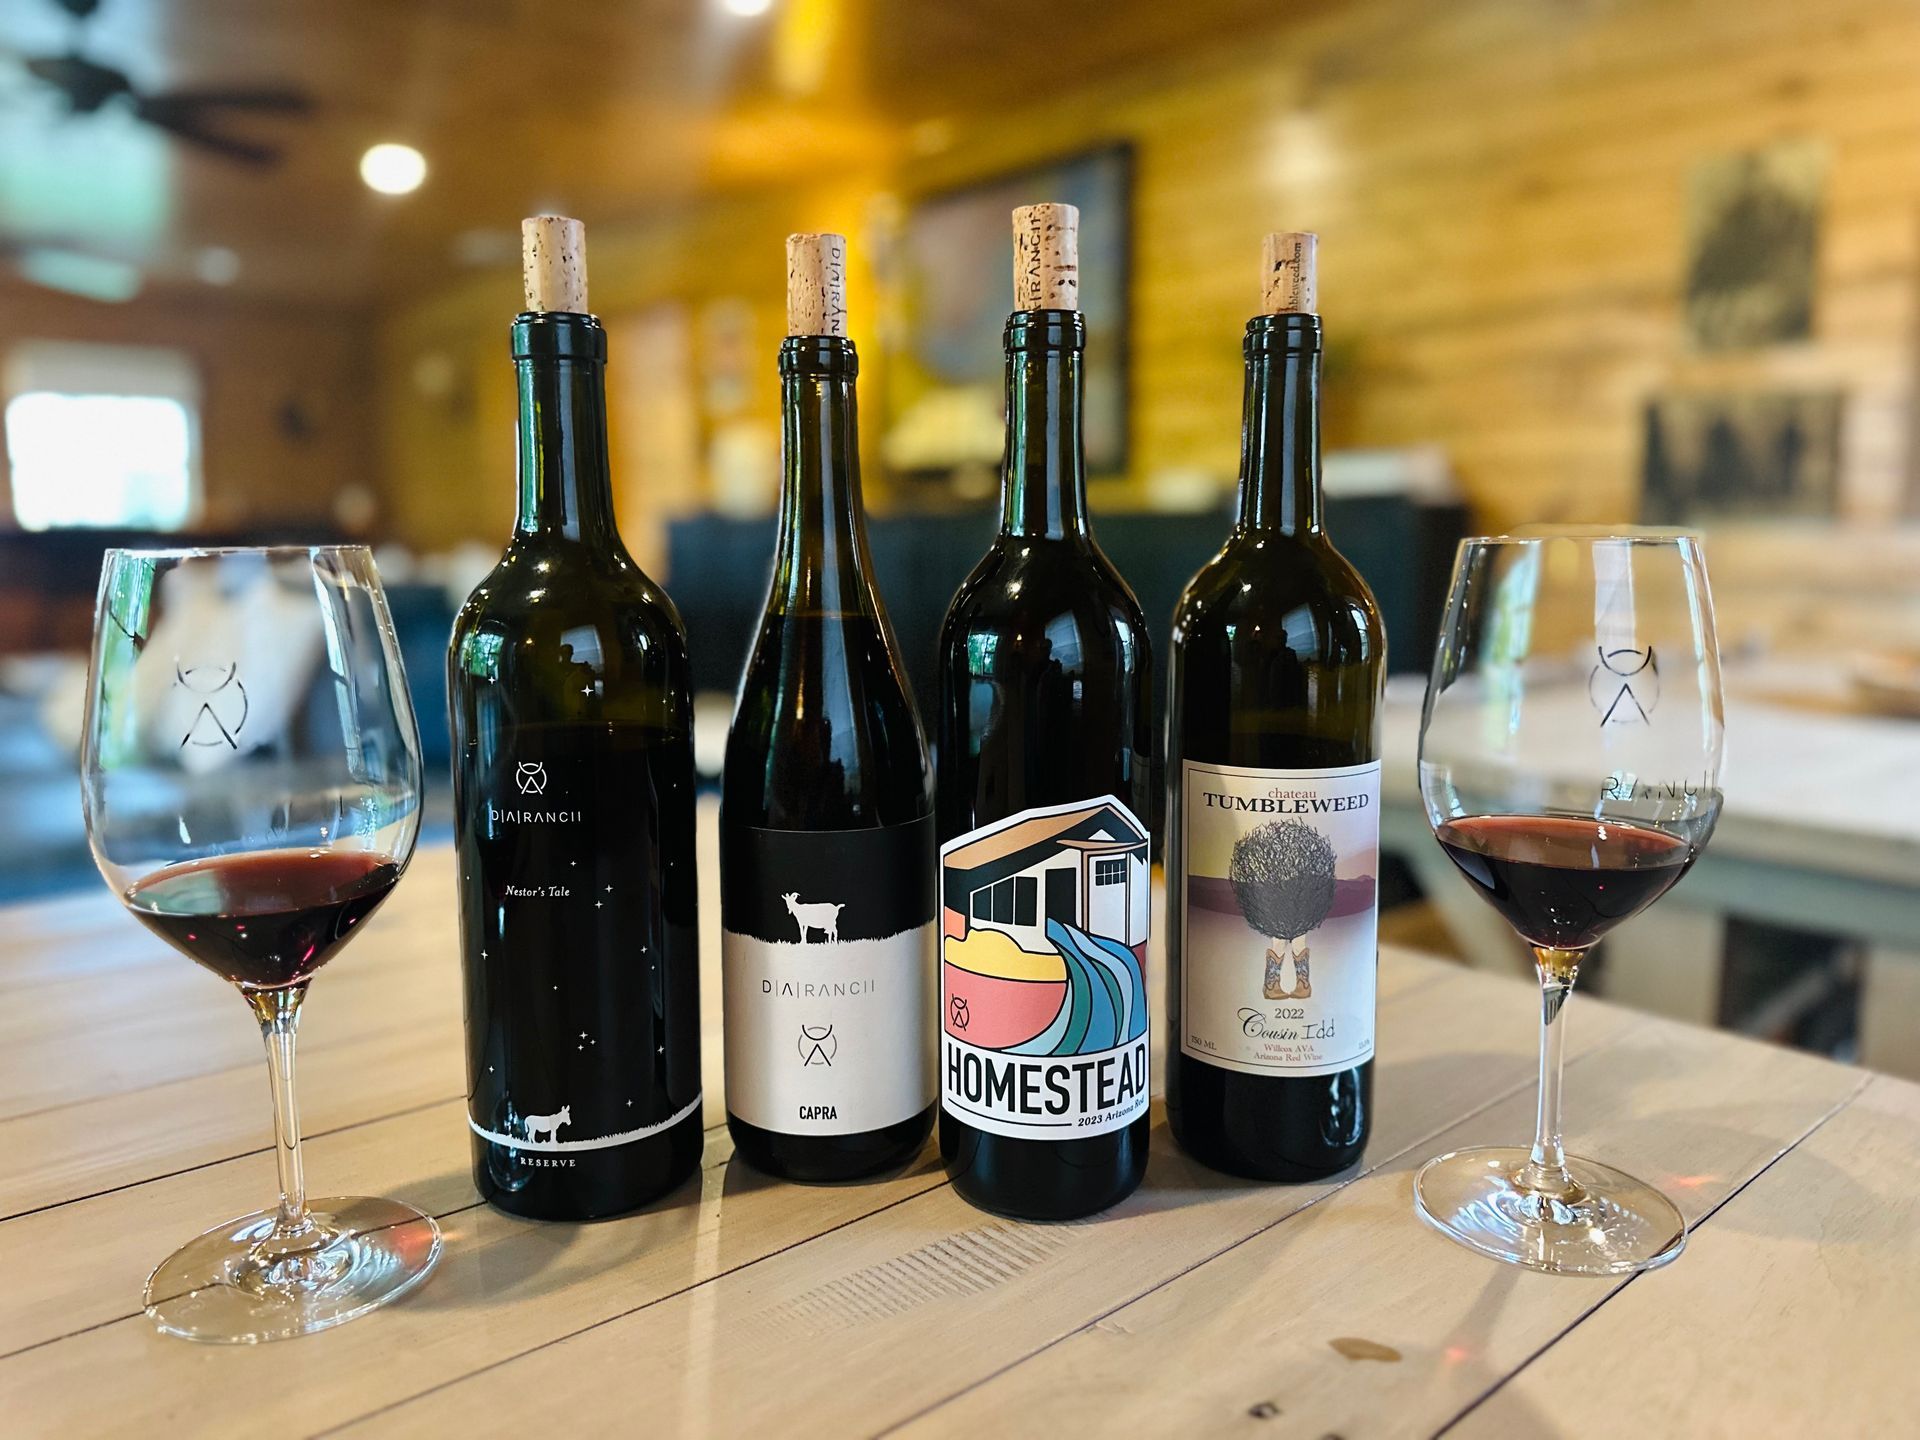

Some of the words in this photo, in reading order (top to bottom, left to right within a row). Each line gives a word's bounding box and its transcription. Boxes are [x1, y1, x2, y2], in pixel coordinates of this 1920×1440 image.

[1268, 787, 1317, 799] chateau
[1203, 792, 1369, 814] TUMBLEWEED
[505, 885, 546, 898] Nestor's
[548, 885, 571, 898] Tale
[1274, 1008, 1304, 1020] 2022
[1237, 1007, 1299, 1040] Cousin
[1264, 1043, 1293, 1053] Willcox
[1295, 1044, 1314, 1053] AVA
[1254, 1052, 1283, 1061] Arizona
[1286, 1053, 1301, 1062] Red
[1304, 1053, 1323, 1061] Wine
[948, 1041, 1147, 1115] HOMESTEAD
[799, 1105, 838, 1120] CAPRA
[1078, 1114, 1103, 1127] 2023
[1105, 1104, 1134, 1122] Arizona
[1134, 1094, 1145, 1109] Red
[520, 1157, 576, 1167] RESERVE
